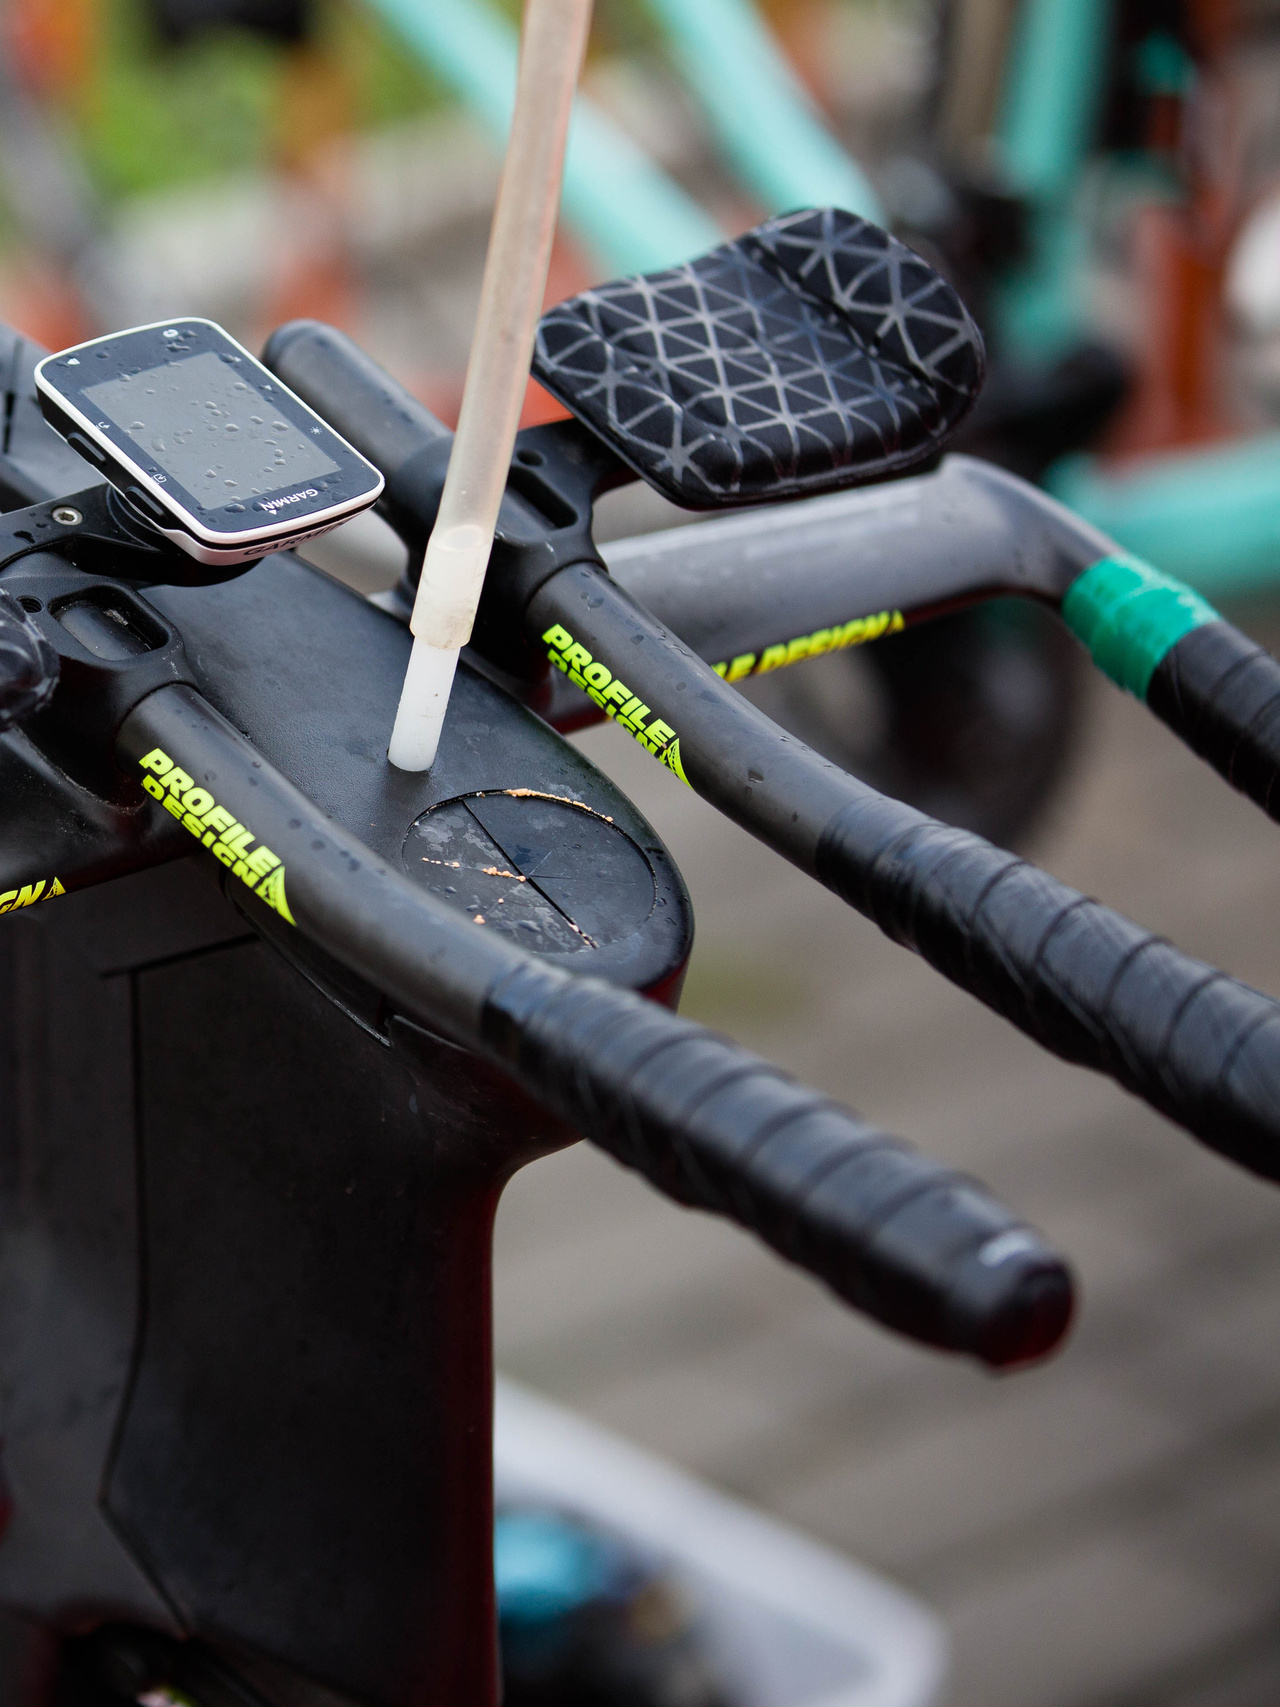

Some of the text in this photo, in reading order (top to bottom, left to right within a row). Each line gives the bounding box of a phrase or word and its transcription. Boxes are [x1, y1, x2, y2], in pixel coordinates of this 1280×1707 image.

[259, 488, 318, 512] GARMIN
[541, 623, 677, 749] PROFILE
[546, 648, 659, 756] DESIGN
[138, 747, 282, 878] PROFILE
[140, 774, 261, 889] DESIGN
